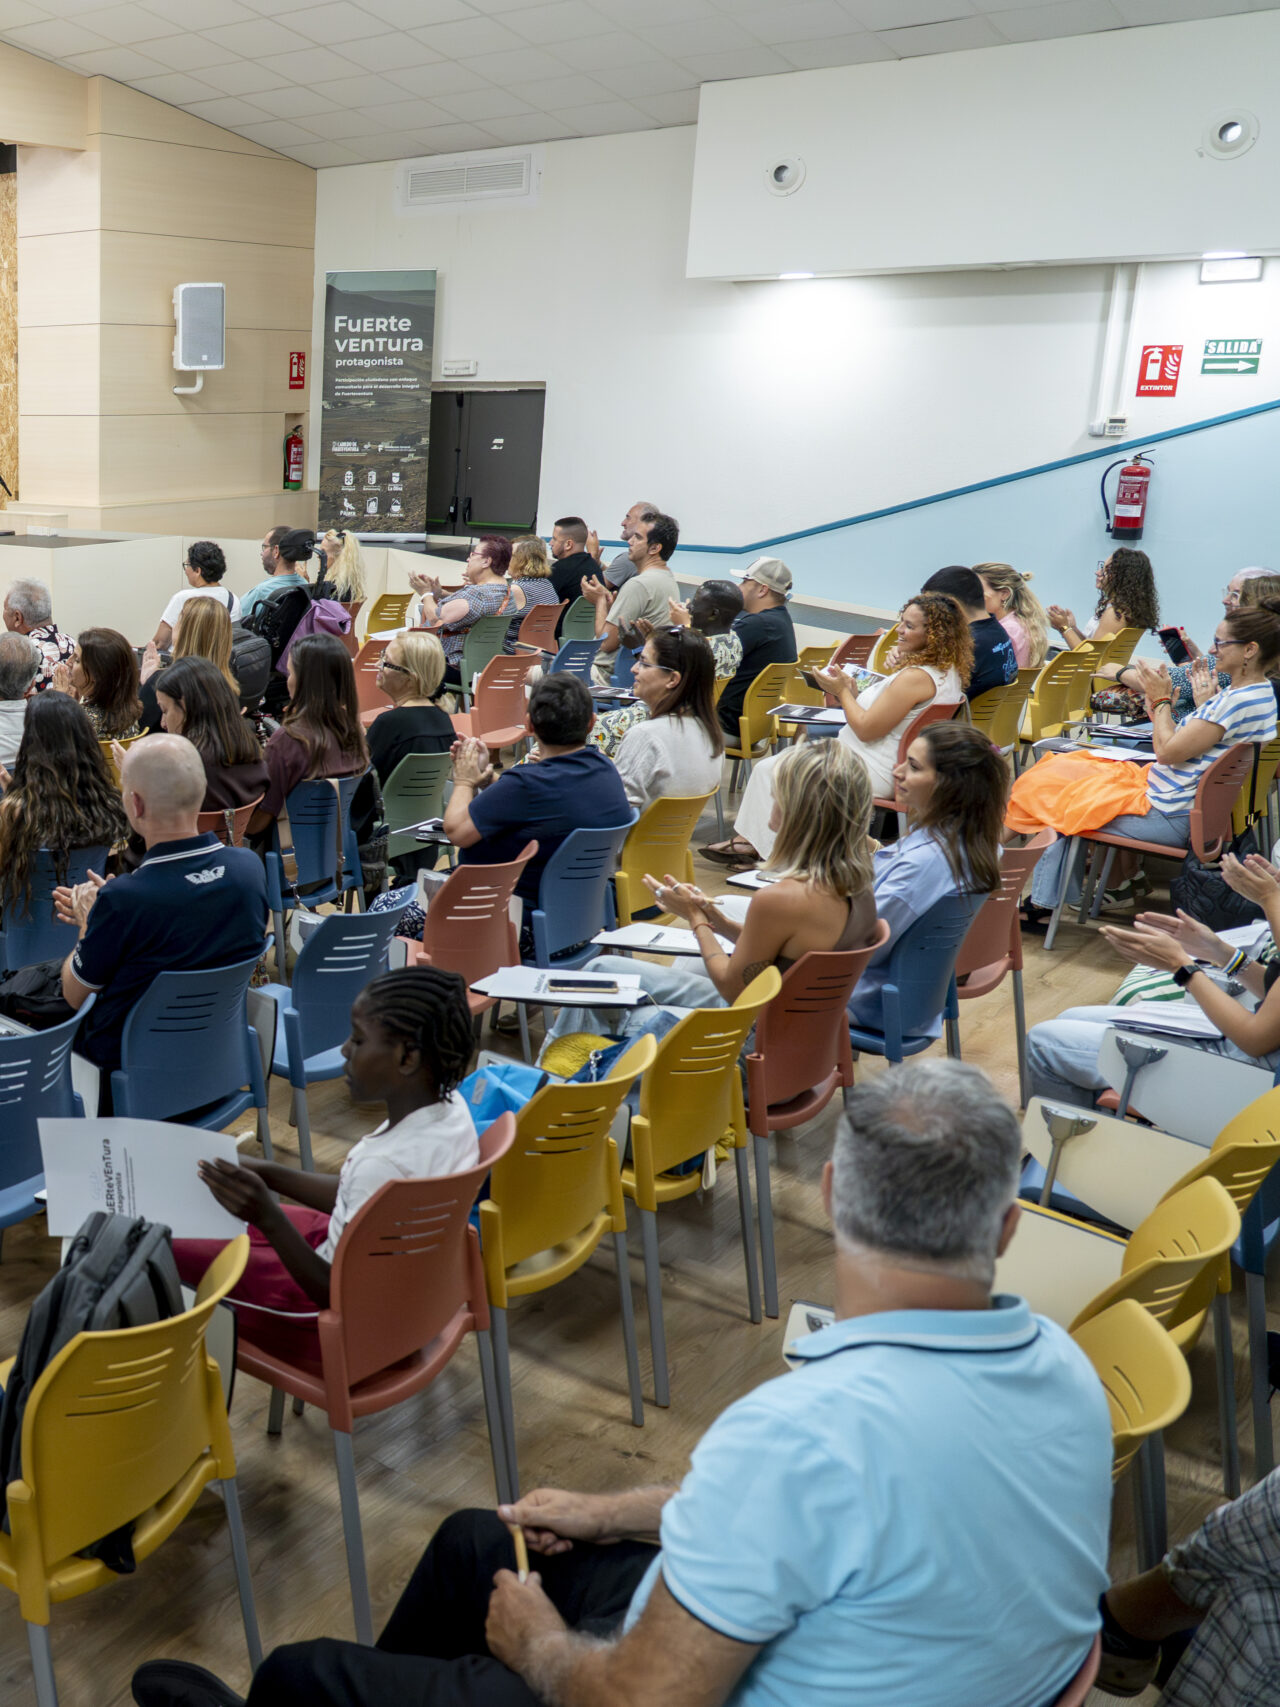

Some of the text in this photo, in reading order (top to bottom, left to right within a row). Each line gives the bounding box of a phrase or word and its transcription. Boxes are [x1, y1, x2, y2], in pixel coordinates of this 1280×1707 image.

[1207, 341, 1258, 354] SALIDA
[335, 356, 404, 368] protagonista
[102, 1138, 116, 1216] uERteVEnTura
